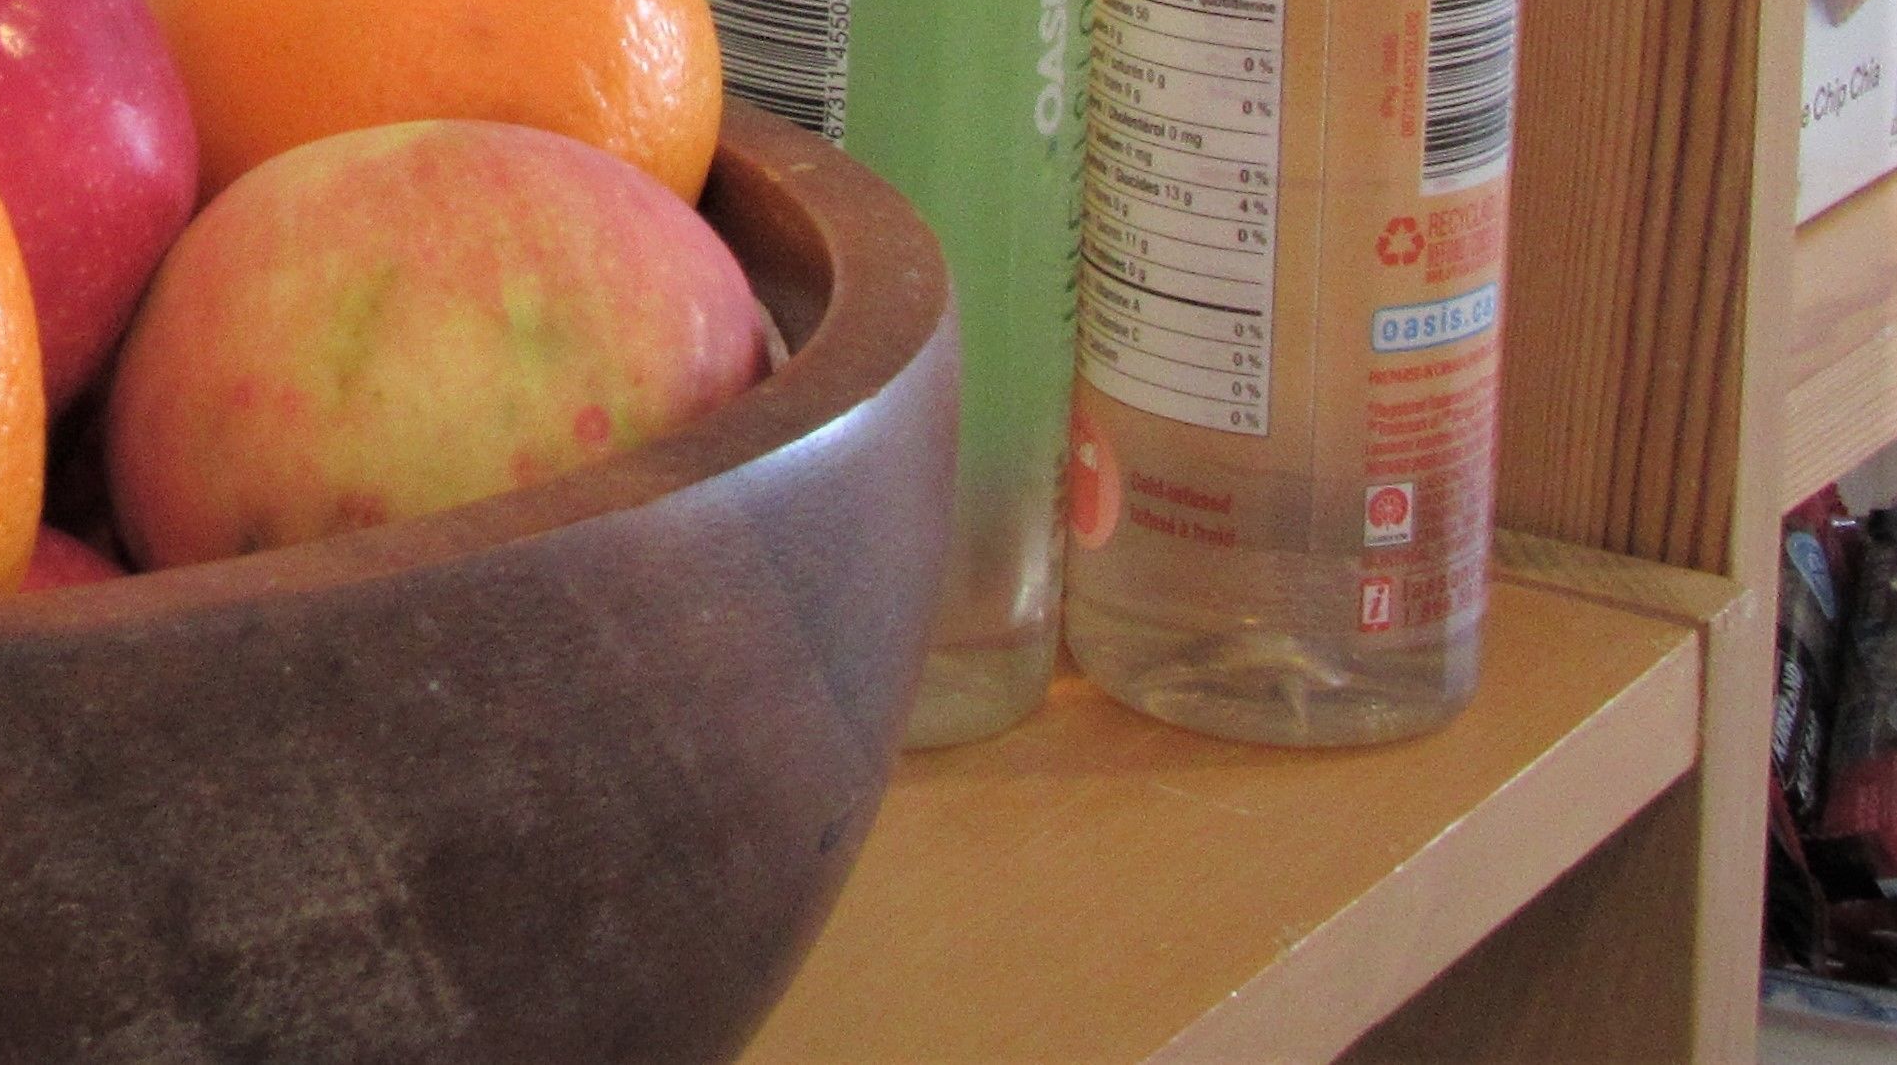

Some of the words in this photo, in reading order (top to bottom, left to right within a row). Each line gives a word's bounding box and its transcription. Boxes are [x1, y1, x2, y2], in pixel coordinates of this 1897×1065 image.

[1243, 57, 1254, 73] 0
[1258, 58, 1273, 74] %
[1813, 77, 1848, 122] Chip
[1850, 57, 1881, 101] Chia
[1242, 99, 1253, 115] 0
[1257, 100, 1272, 118] %
[1180, 131, 1203, 150] mg
[1240, 169, 1250, 184] 0
[1255, 170, 1269, 185] %
[1164, 183, 1180, 201] 13
[1253, 199, 1269, 216] %
[1237, 228, 1248, 243] 0
[1252, 229, 1268, 246] %
[1234, 322, 1245, 337] 0
[1248, 323, 1264, 340] %
[1232, 351, 1244, 368] 0
[1247, 353, 1263, 370] %
[1231, 381, 1243, 397] 0
[1246, 382, 1262, 400] %
[1230, 410, 1242, 427] 0
[1244, 412, 1261, 429] %
